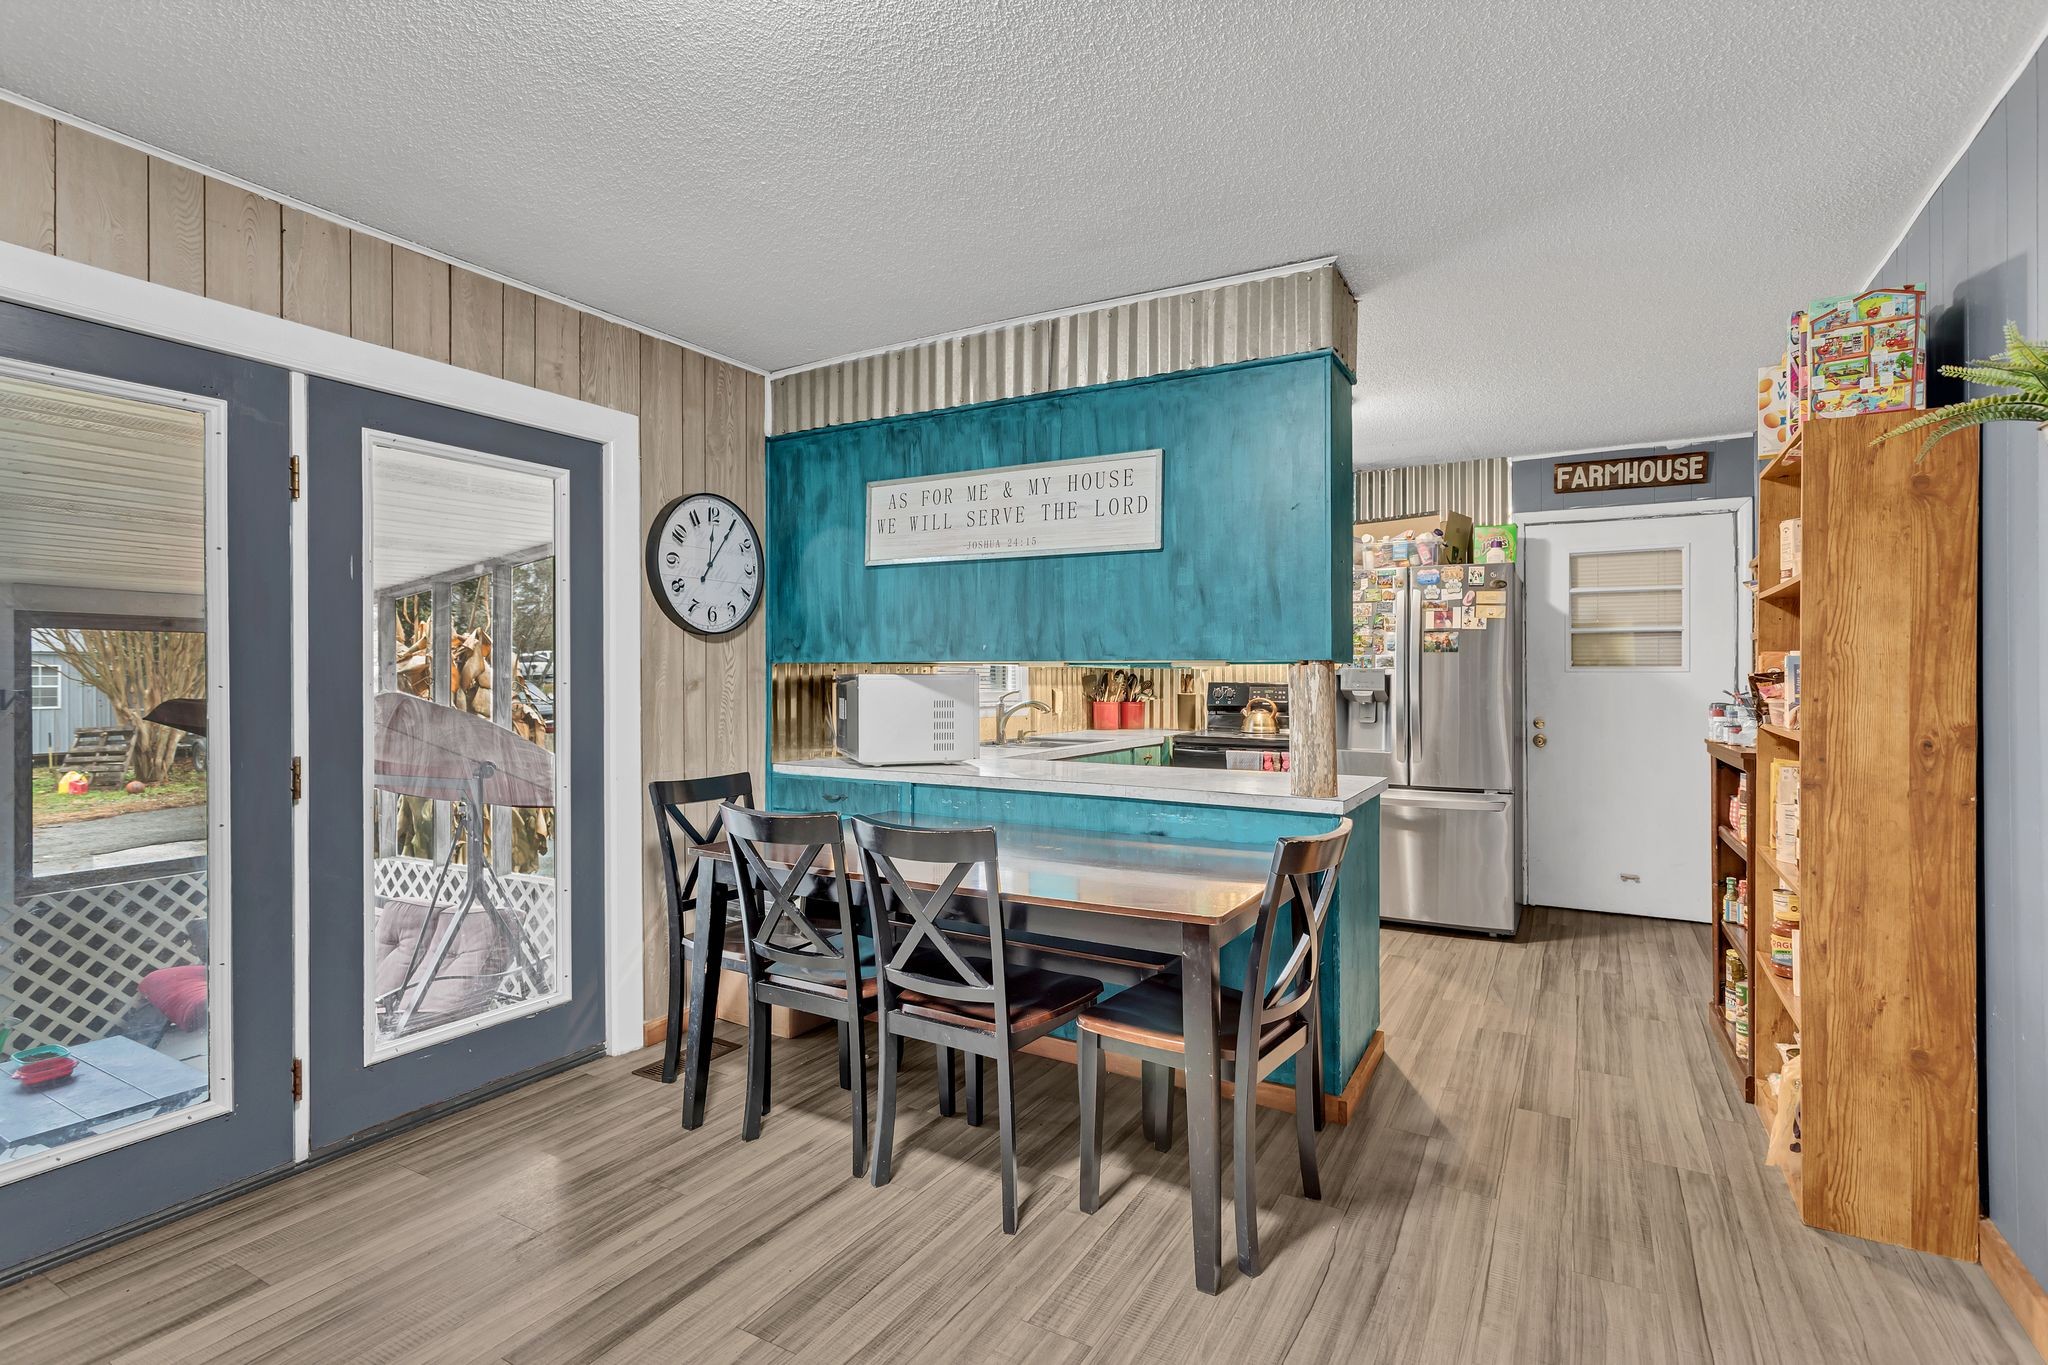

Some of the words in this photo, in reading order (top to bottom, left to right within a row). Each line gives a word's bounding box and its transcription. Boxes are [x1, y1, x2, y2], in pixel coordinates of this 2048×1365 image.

[1556, 455, 1704, 490] FARMHOUSE
[888, 492, 908, 510] AS
[921, 487, 953, 507] FOR
[967, 483, 989, 502] ME
[1003, 480, 1013, 499] &
[1028, 476, 1052, 496] MY
[1067, 468, 1134, 492] HOUSE
[689, 508, 701, 527] 11
[708, 506, 720, 523] 12
[877, 517, 897, 535] WE
[909, 512, 953, 532] WILL
[966, 505, 1025, 528] SERVE
[1041, 501, 1078, 521] THE
[1095, 495, 1149, 517] LORD
[671, 523, 687, 544] 10
[1007, 536, 1037, 548] 24:15
[739, 538, 752, 553] 2
[666, 551, 680, 565] 9
[671, 577, 685, 593] 8
[688, 598, 700, 613] 7
[707, 605, 718, 623] 6
[727, 600, 737, 617] 5
